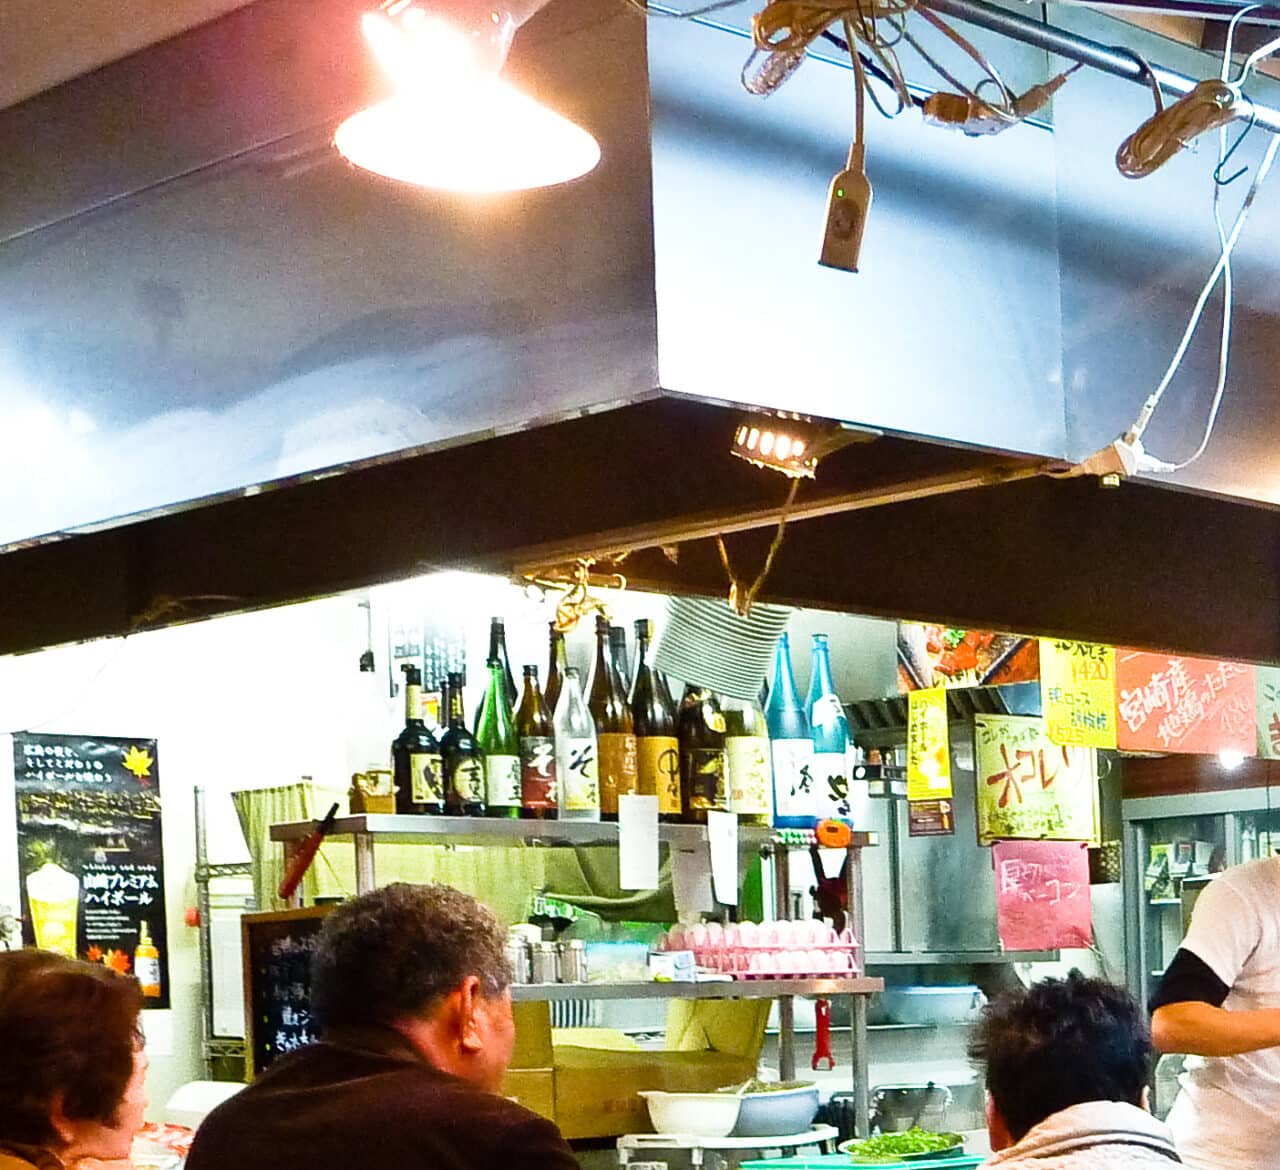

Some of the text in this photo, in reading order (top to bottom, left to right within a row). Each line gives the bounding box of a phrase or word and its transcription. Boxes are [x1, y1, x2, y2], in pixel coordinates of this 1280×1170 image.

[84, 890, 154, 906] ハイボール
